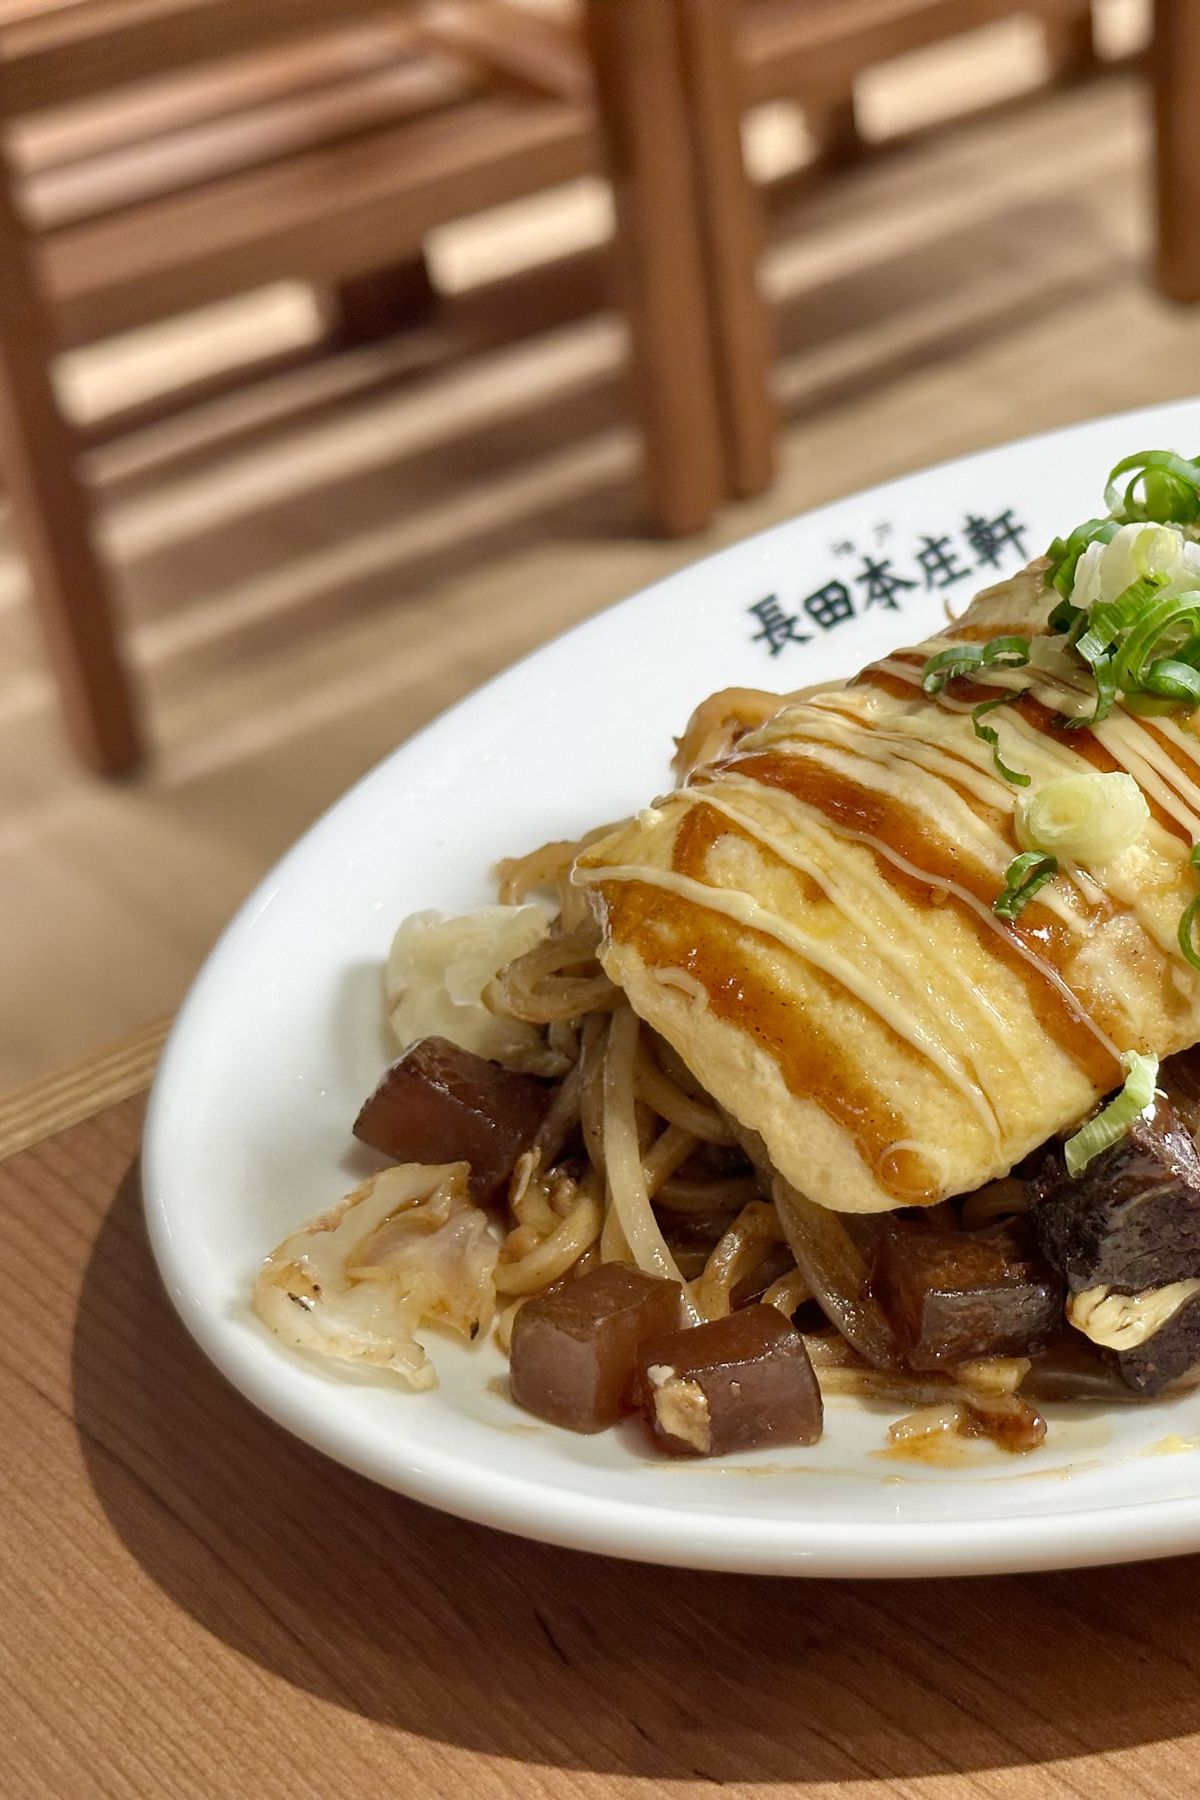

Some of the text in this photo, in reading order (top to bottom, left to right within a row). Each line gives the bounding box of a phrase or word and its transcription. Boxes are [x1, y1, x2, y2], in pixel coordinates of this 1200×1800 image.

[748, 509, 1028, 657] 長田本庄軒
